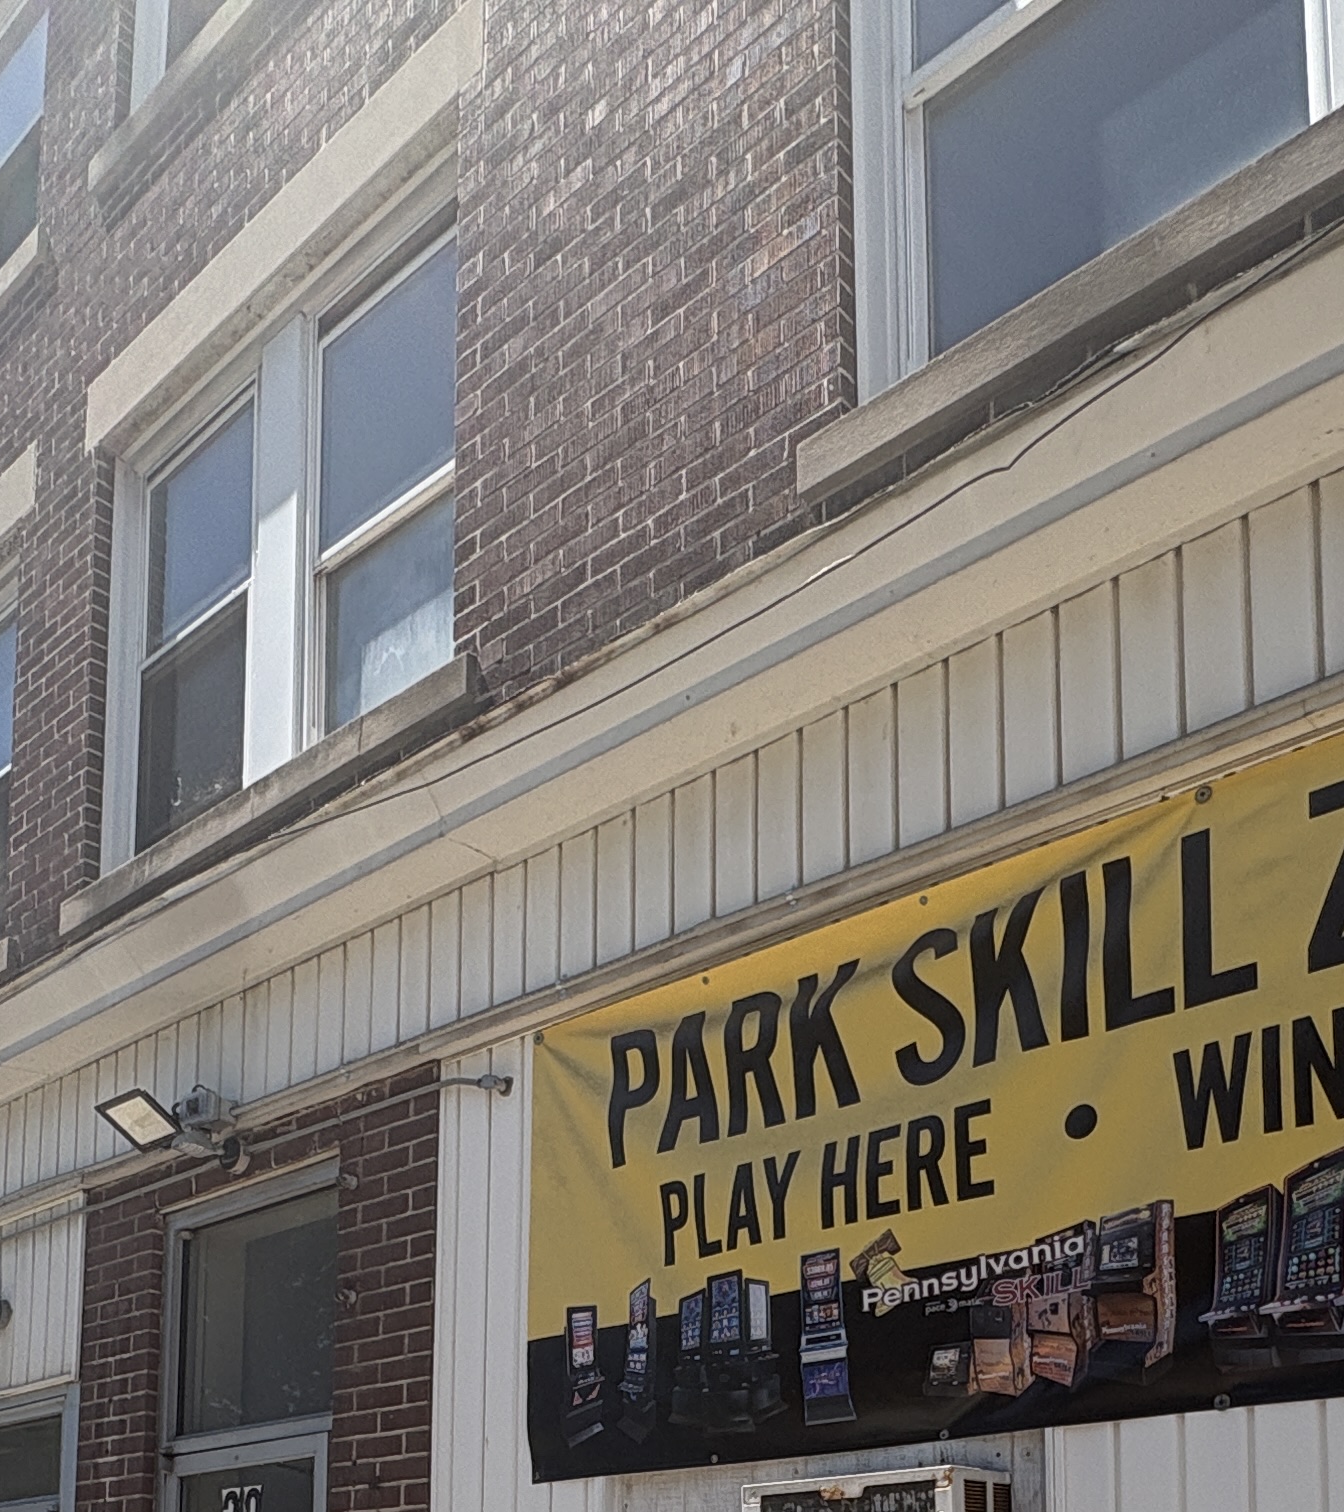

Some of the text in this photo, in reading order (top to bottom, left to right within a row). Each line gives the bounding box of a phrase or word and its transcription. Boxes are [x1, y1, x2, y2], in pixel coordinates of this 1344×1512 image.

[607, 961, 860, 1168] PARK
[892, 827, 1257, 1084] SKILL
[659, 1150, 800, 1266] PLAY
[820, 1101, 995, 1230] HERE
[862, 1233, 1086, 1313] Pennsylvania
[992, 1265, 1092, 1307] SKILL
